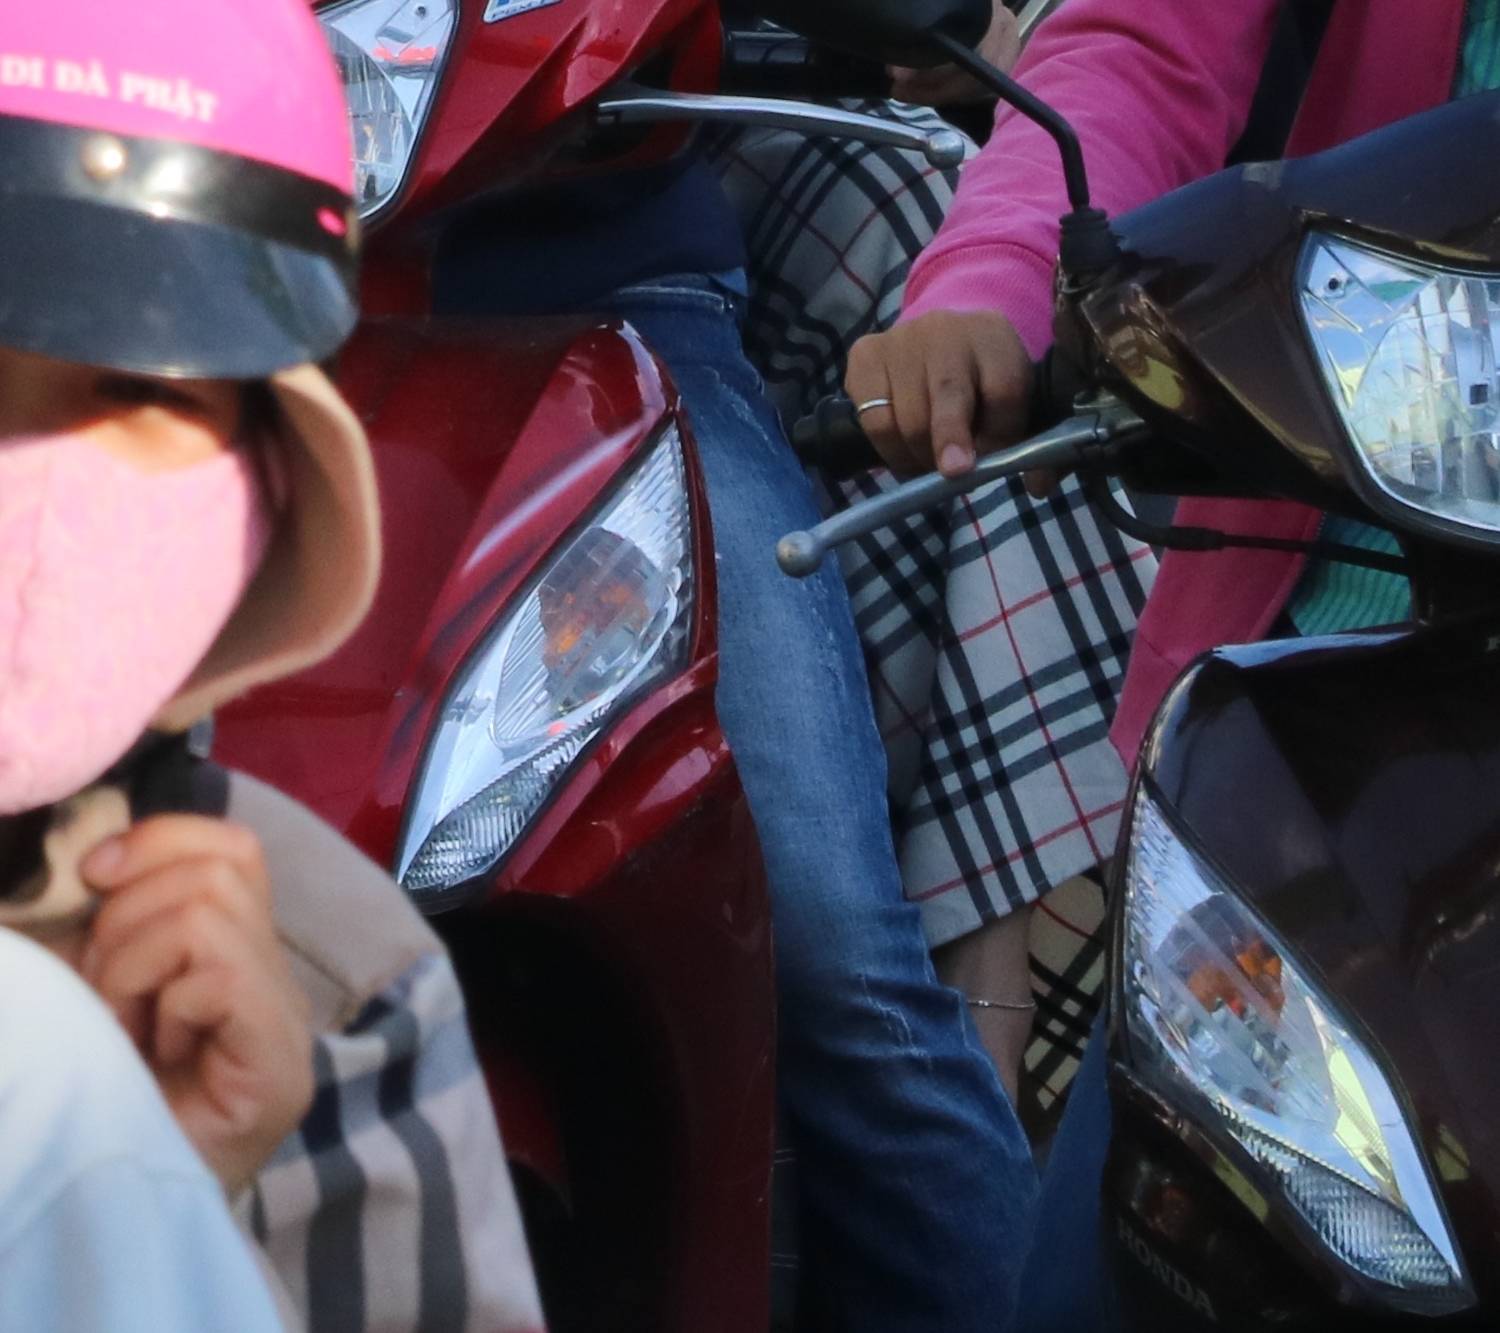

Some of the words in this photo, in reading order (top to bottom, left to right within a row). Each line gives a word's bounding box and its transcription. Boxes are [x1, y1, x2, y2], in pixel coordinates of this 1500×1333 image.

[1, 56, 44, 89] DI
[56, 55, 110, 98] ĐÀ
[121, 71, 219, 123] PHẬT
[1117, 1215, 1218, 1322] HONDA
